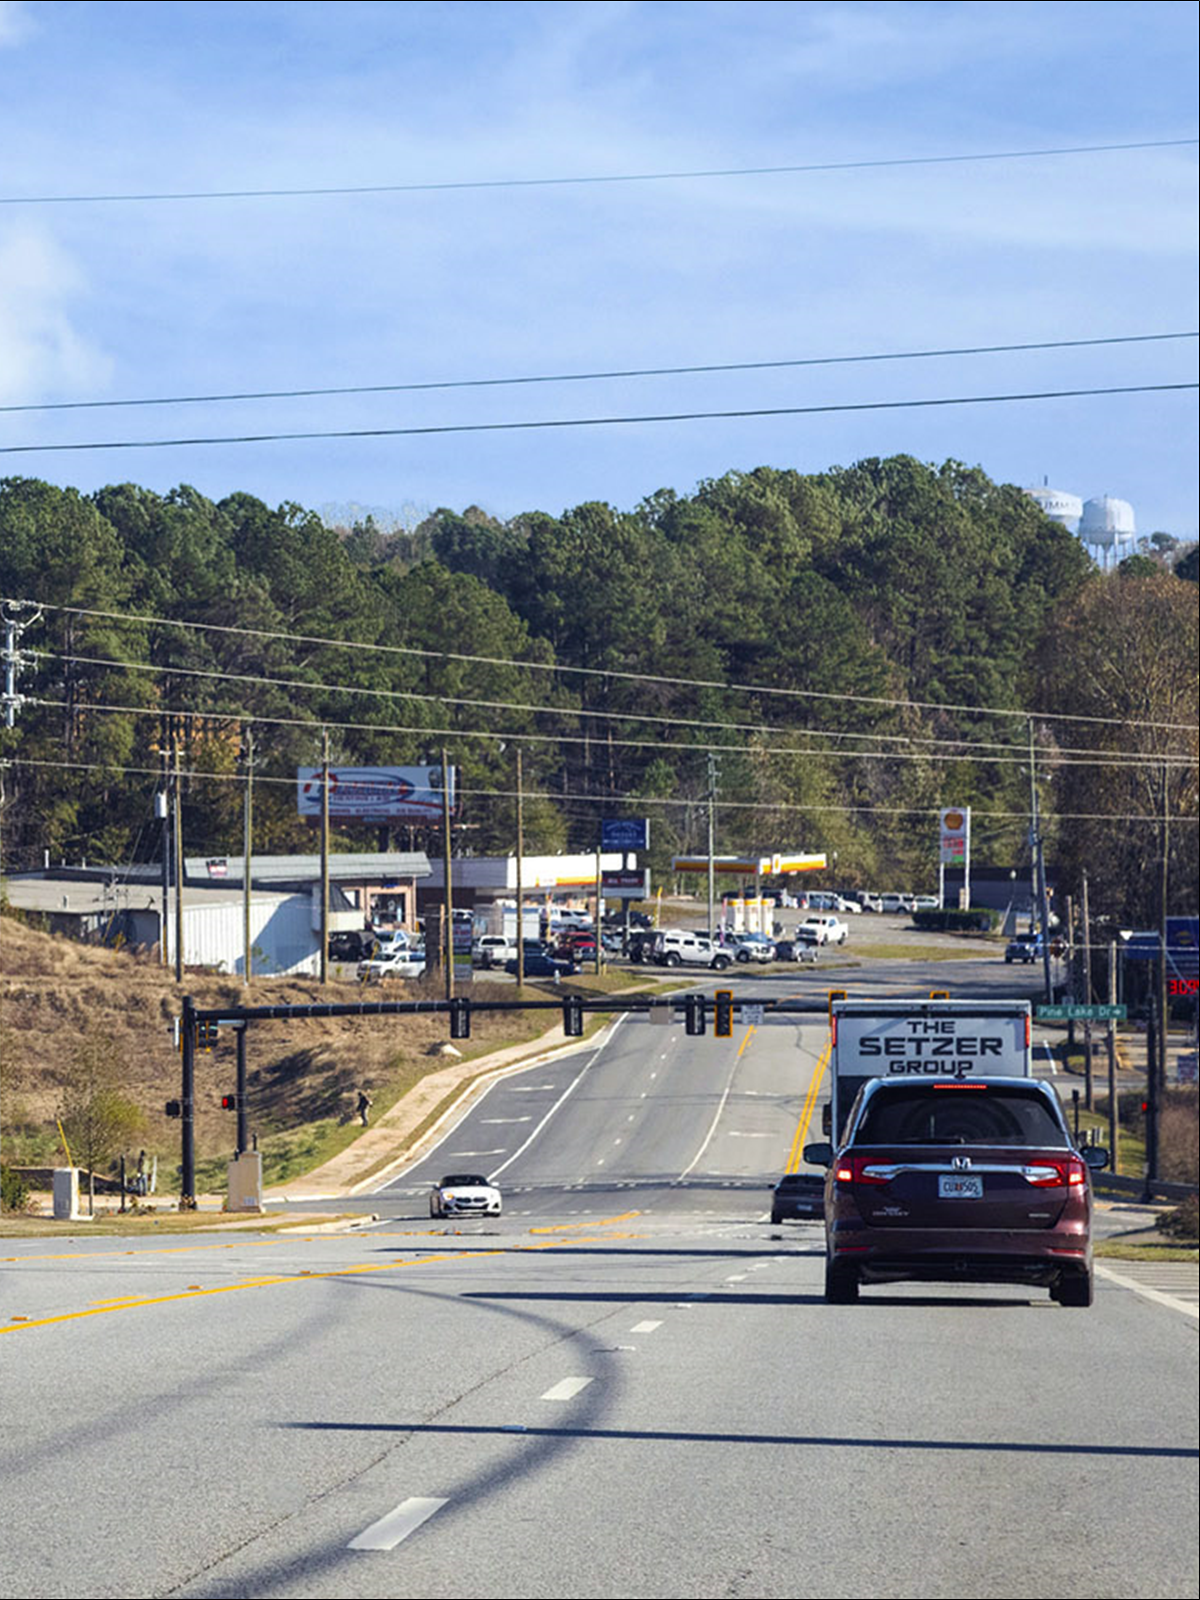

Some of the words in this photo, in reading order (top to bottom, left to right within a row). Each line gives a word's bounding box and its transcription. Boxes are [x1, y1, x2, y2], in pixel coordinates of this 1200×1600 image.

[1040, 1006, 1063, 1017] Pine
[1068, 1006, 1093, 1017] Lake
[1100, 1006, 1111, 1017] Dr
[907, 1021, 956, 1034] THE
[859, 1037, 1003, 1056] SETZER
[889, 1060, 973, 1074] GROUP
